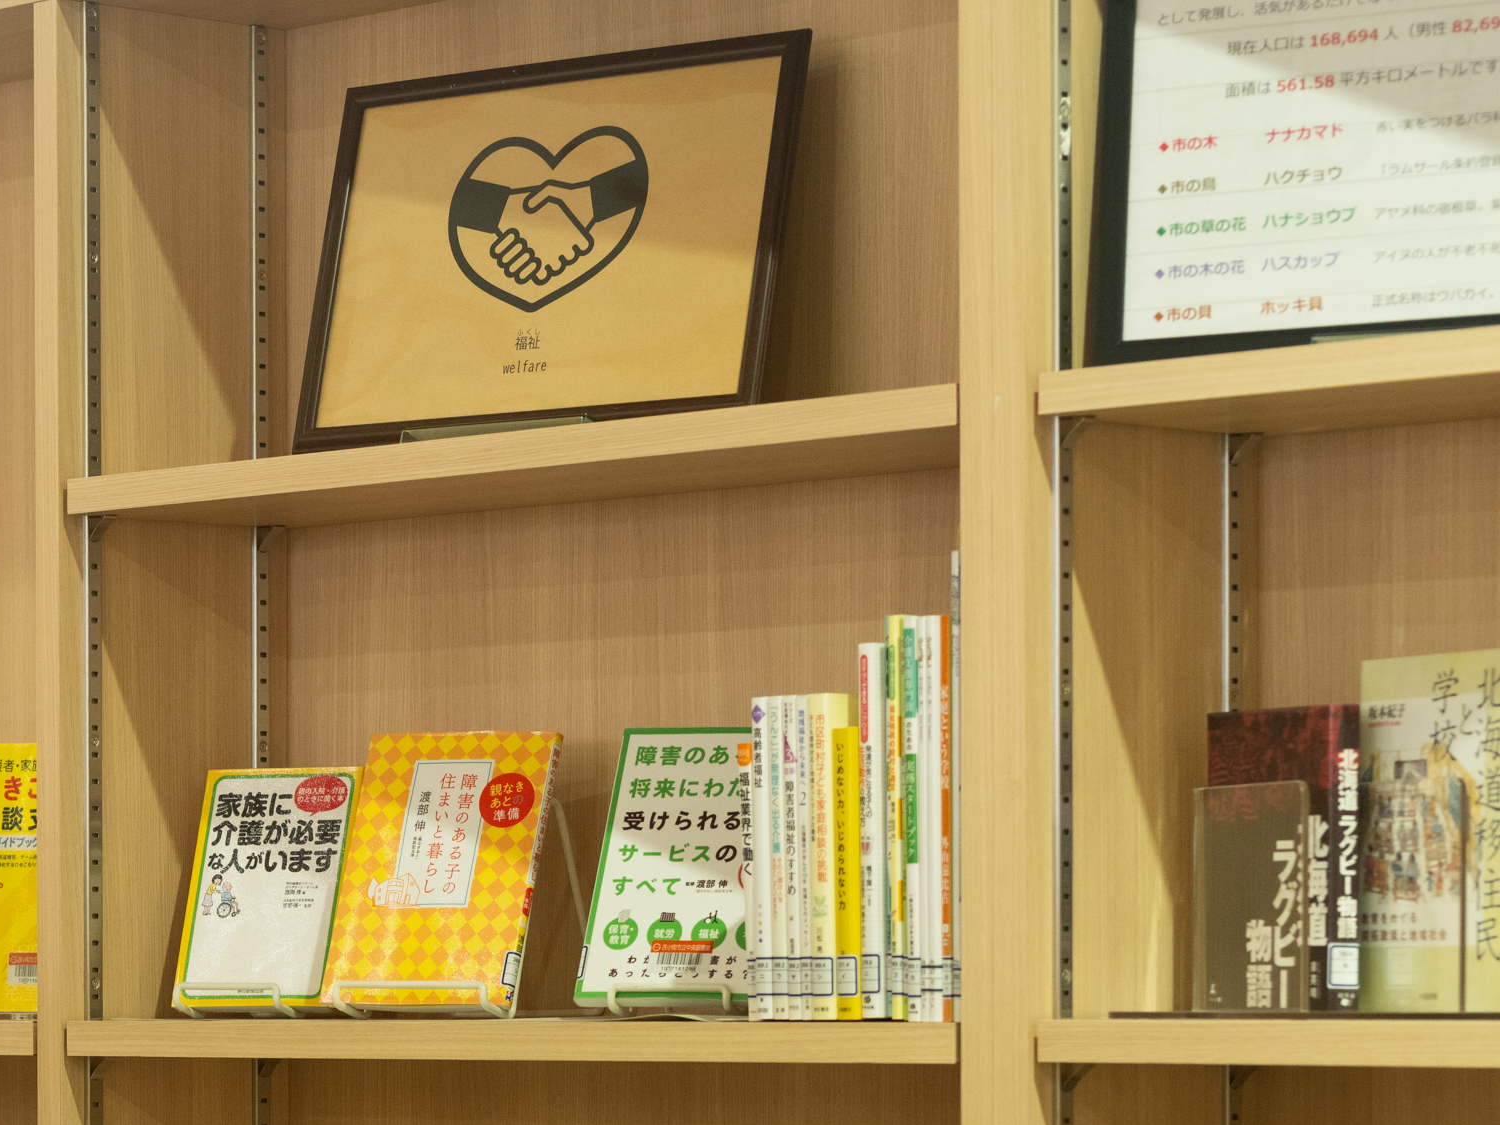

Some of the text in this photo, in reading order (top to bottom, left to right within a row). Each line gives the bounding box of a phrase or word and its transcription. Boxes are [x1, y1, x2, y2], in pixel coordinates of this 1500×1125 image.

[1227, 37, 1305, 56] 現在人口は
[1310, 28, 1379, 49] 168,694
[1225, 80, 1271, 99] 面積は
[1276, 75, 1335, 93] 561.58
[1172, 135, 1218, 153] 市の木
[1265, 123, 1344, 144] ナナカマド
[1171, 166, 1343, 194] 市の鳥 ハクチョウ
[1169, 206, 1357, 237] 市の草の花 ハナショウブ
[1168, 252, 1341, 280] 市の木の花 ハスカップ
[1167, 305, 1212, 322] 市の貝
[1260, 297, 1323, 315] ホッキ貝
[514, 335, 541, 350] 福祉
[517, 328, 541, 336] ふくし
[502, 359, 547, 375] welfare
[1429, 667, 1459, 763] 学校
[635, 746, 738, 766] 障害のあ
[752, 727, 764, 789] 高齢者福祉
[490, 781, 524, 796] 親なき
[490, 795, 524, 809] あとの
[629, 778, 741, 799] 将来にわた
[815, 714, 828, 883] 市区町村子ども家庭相談の挑戦
[215, 792, 293, 819] 家族に
[493, 808, 519, 821] 準備
[212, 819, 342, 847] 介護が必要
[414, 820, 426, 832] 伸
[423, 773, 456, 894] 住まいと暮らし
[442, 773, 479, 895] 障害のある子の
[623, 811, 741, 831] 受けられる
[739, 772, 754, 875] 福祉業界で働く
[835, 743, 847, 911] いじめない力、いじめられない力
[785, 780, 797, 896] 障害者福祉のすすめ
[1336, 748, 1358, 940] 北海道 ラグビー物語
[208, 847, 338, 874] な人がいます
[619, 844, 737, 863] サービスの
[612, 876, 681, 896] すべて
[654, 928, 674, 939] 就労
[698, 928, 719, 939] 福祉
[1271, 839, 1303, 1010] ラグビー
[608, 934, 630, 945] 教育
[1246, 919, 1273, 1009] 物語
